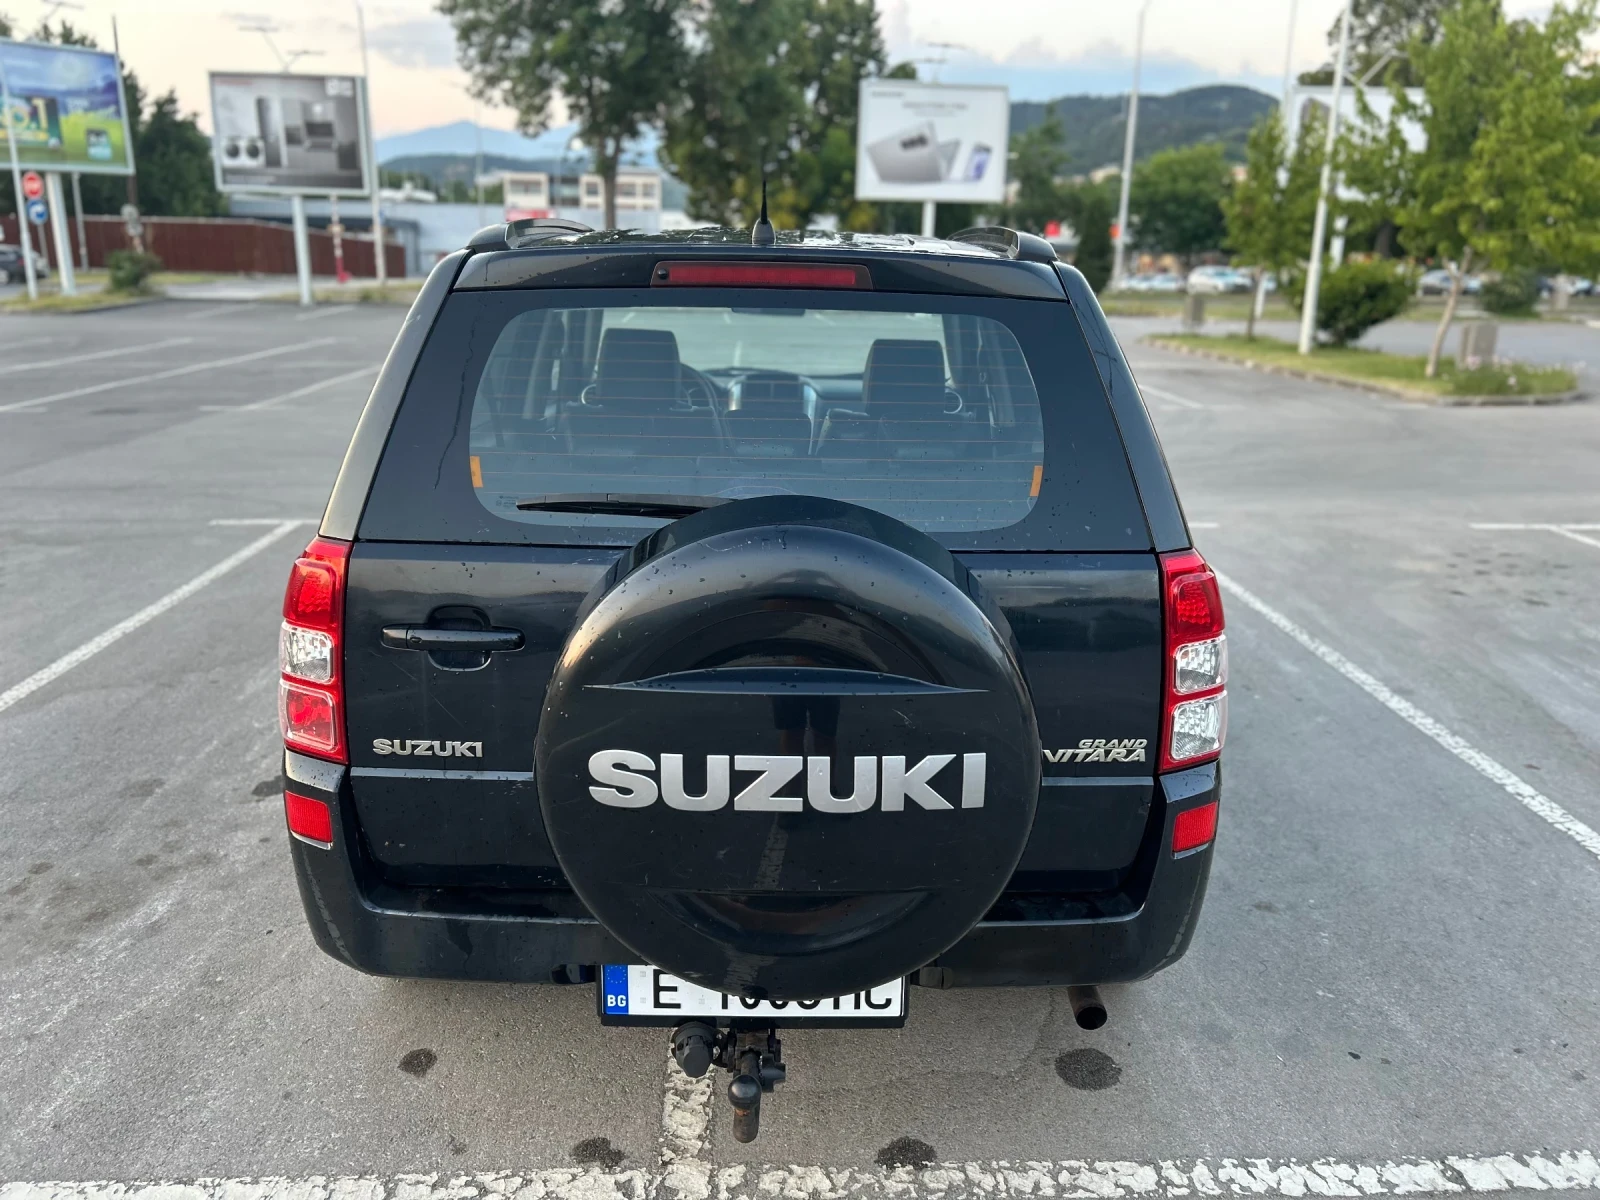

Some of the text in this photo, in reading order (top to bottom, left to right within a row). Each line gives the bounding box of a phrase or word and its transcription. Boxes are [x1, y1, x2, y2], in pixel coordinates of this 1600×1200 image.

[373, 738, 483, 758] SUZUKI
[1078, 739, 1148, 749] GRAND
[1042, 749, 1146, 763] VITARA
[588, 749, 987, 813] SUZUKI
[653, 968, 682, 1009] E
[607, 994, 627, 1007] BG
